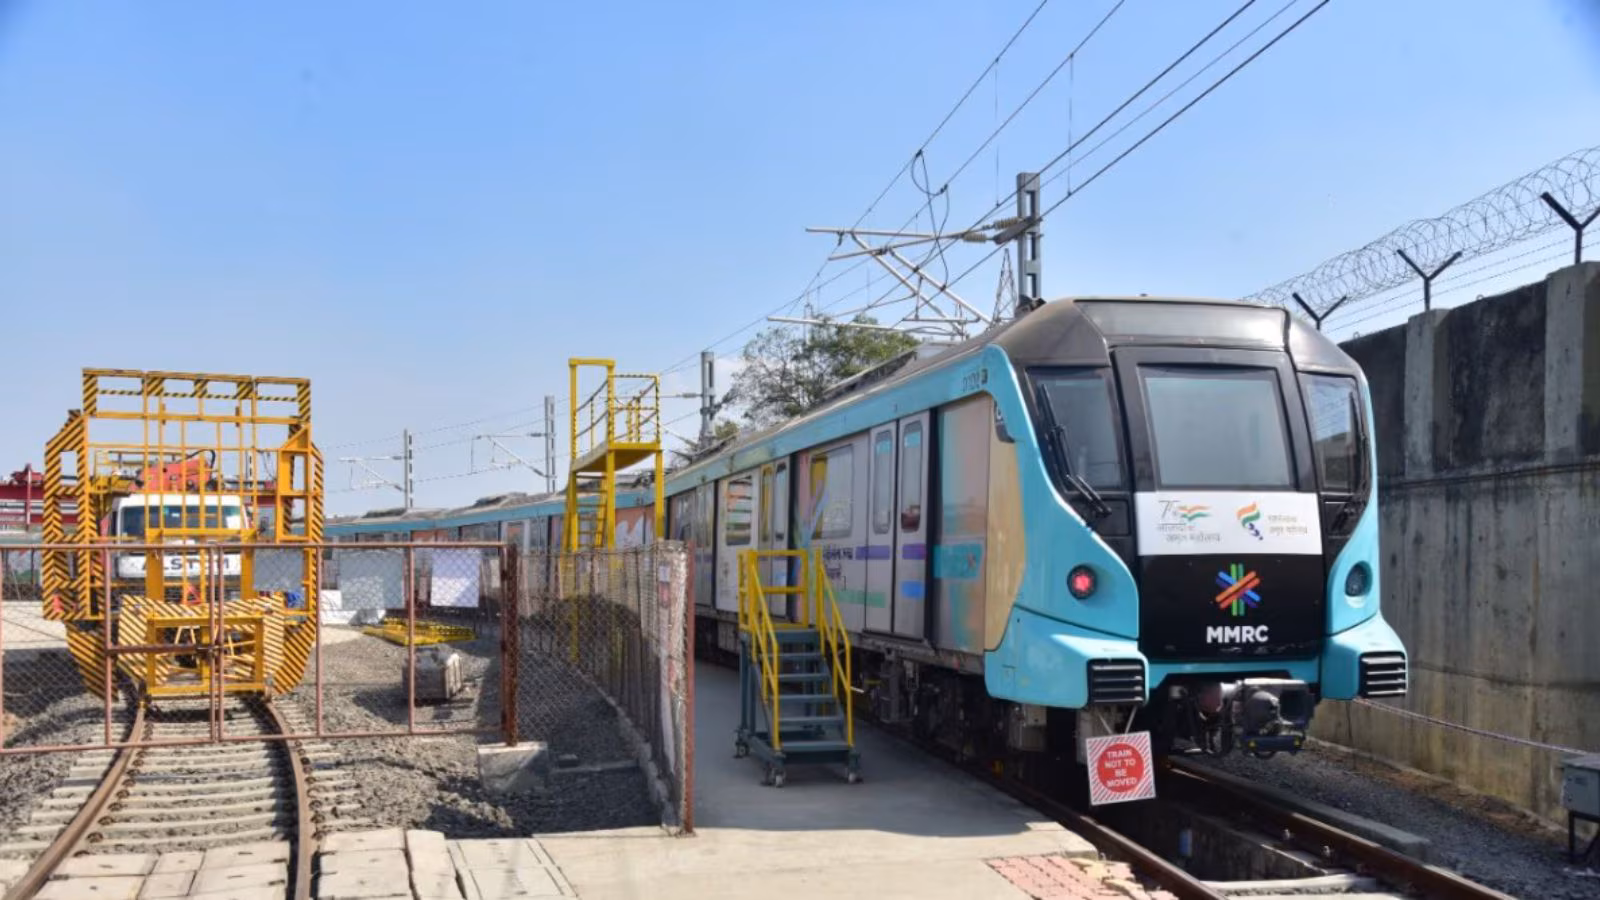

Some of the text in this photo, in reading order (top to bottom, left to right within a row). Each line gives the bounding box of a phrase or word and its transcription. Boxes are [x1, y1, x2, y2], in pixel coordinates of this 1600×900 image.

[1206, 625, 1269, 643] MMRC
[1107, 749, 1132, 758] TRAIN
[1104, 758, 1136, 769] NOT TO
[1114, 768, 1127, 777] BE
[1106, 777, 1137, 787] MOVED
